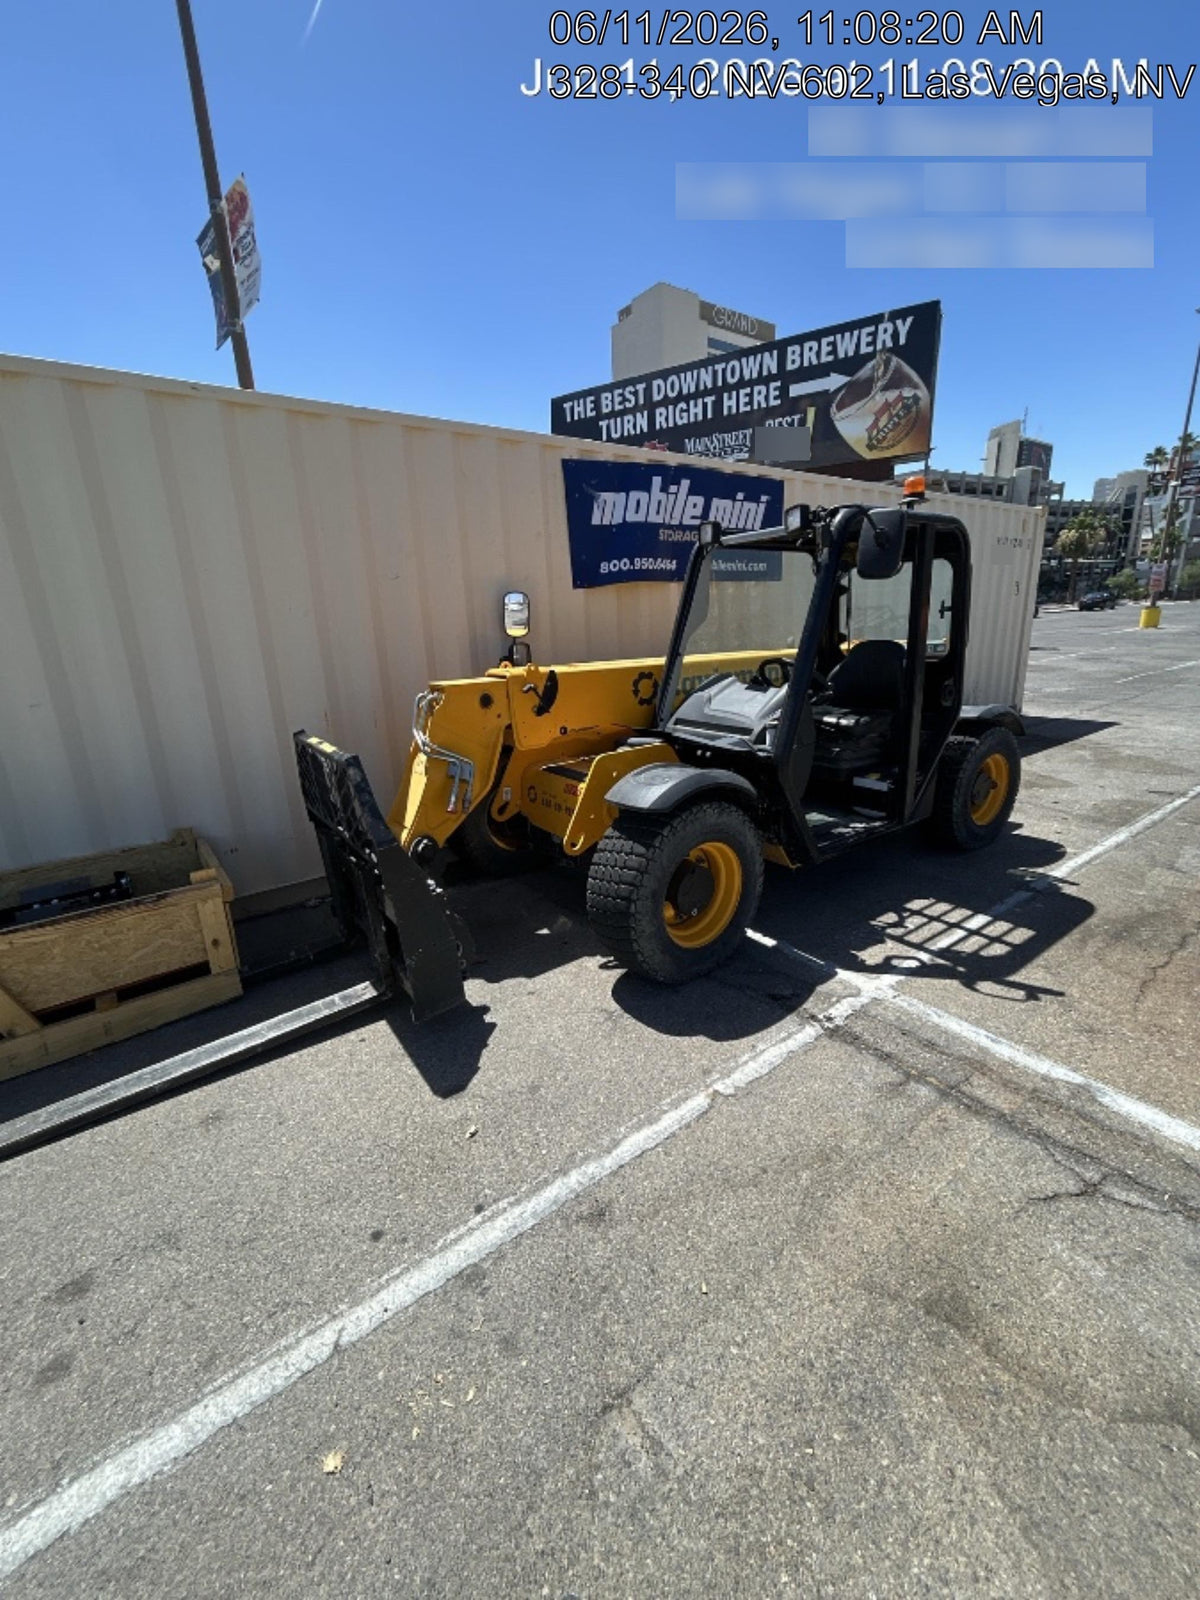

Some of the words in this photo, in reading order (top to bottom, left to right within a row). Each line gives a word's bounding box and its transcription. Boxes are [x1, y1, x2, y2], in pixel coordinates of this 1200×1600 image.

[712, 306, 759, 336] GRAND
[563, 395, 597, 423] THE
[601, 382, 646, 414] BEST
[651, 349, 779, 401] DOWNTOWN
[785, 315, 915, 372] BREWERY
[598, 415, 648, 442] TURN
[654, 395, 719, 428] RIGHT
[722, 380, 783, 417] HERE
[591, 476, 705, 526] mobile
[709, 492, 768, 531] mini
[659, 528, 700, 543] STORAG
